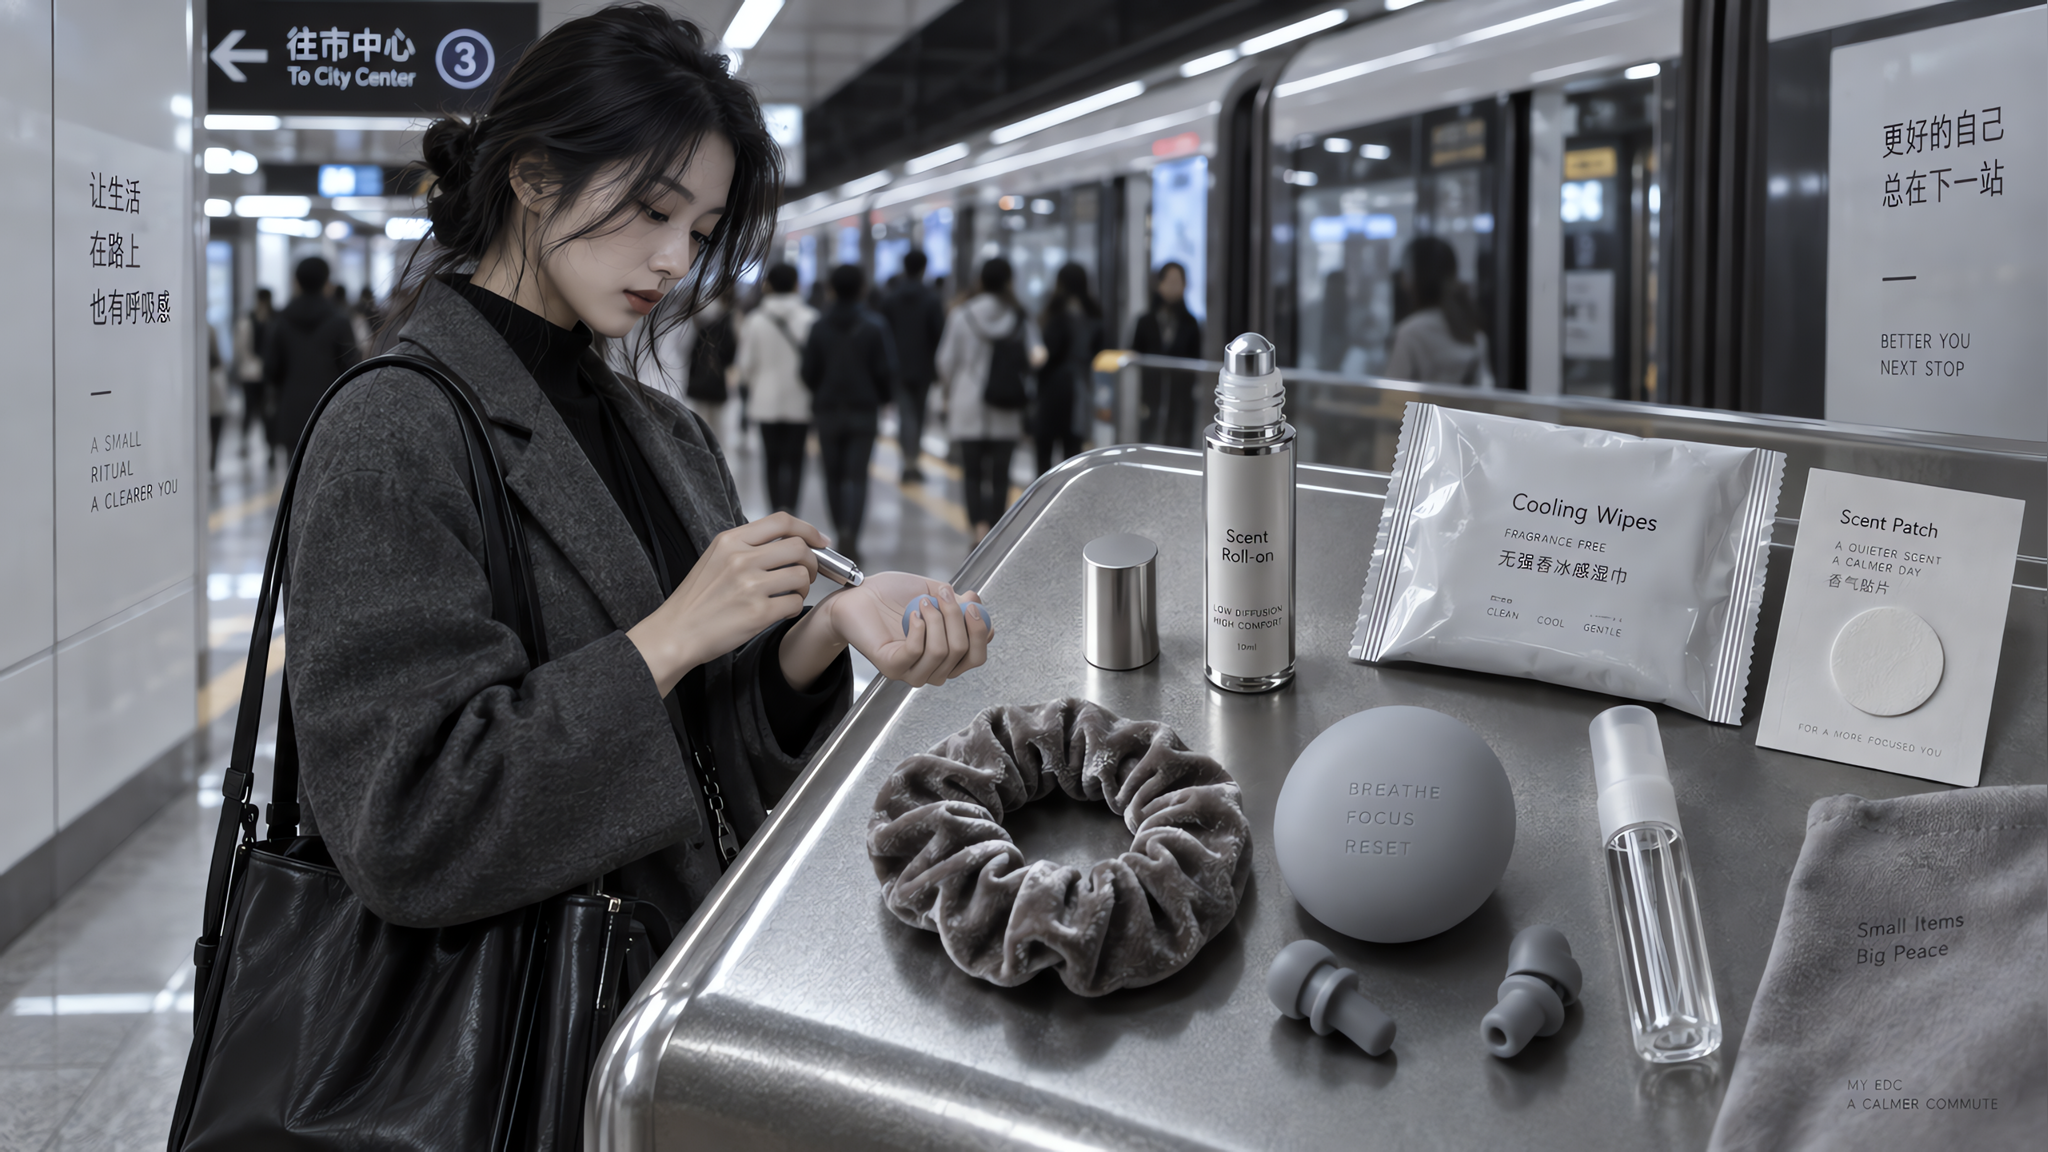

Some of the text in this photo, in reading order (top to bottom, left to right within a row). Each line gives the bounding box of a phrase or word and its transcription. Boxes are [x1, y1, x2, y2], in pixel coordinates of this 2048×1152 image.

[286, 26, 416, 62] 往市中心
[454, 41, 476, 77] 3
[287, 65, 416, 91] To City Center
[1883, 106, 2004, 158] 更好的自己
[89, 171, 141, 214] 让生活
[1883, 159, 2004, 208] 总在下一站
[89, 230, 141, 269] 在路上
[89, 288, 171, 325] 也有呼吸感
[1881, 333, 1971, 349] BETTER YOU
[1880, 360, 1965, 377] NEXT STOP
[90, 431, 142, 454] A SMALL
[91, 460, 134, 483] RITUAL
[90, 479, 178, 513] A CLEARER YOU
[1512, 492, 1658, 532] Cooling Wipes
[1840, 509, 1938, 539] Scent Patch
[1226, 528, 1269, 544] Scent
[1504, 528, 1607, 553] FRAGRANCE FREE
[1222, 547, 1274, 564] Roll-on
[1834, 541, 1843, 551] A
[1903, 551, 1942, 565] SCENT
[1831, 556, 1922, 577] A CALMER DAY
[1213, 604, 1283, 617] LOW DIFFUSION
[1213, 616, 1283, 630] HIGH COMFORT
[1486, 607, 1622, 638] CLEAN COOL GENTLE
[1237, 643, 1257, 651] 10ml
[1798, 723, 1942, 758] FOR A MORE FOCUSED YOU
[1348, 782, 1440, 799] BREATHE
[1346, 810, 1414, 826] FOCUS
[1345, 839, 1411, 856] RESET
[1857, 915, 1964, 938] Small Items
[1857, 944, 1949, 967] Big Peace
[1847, 1080, 1903, 1091] MY EDC
[1846, 1098, 1998, 1110] A CALMER COMMUTE
